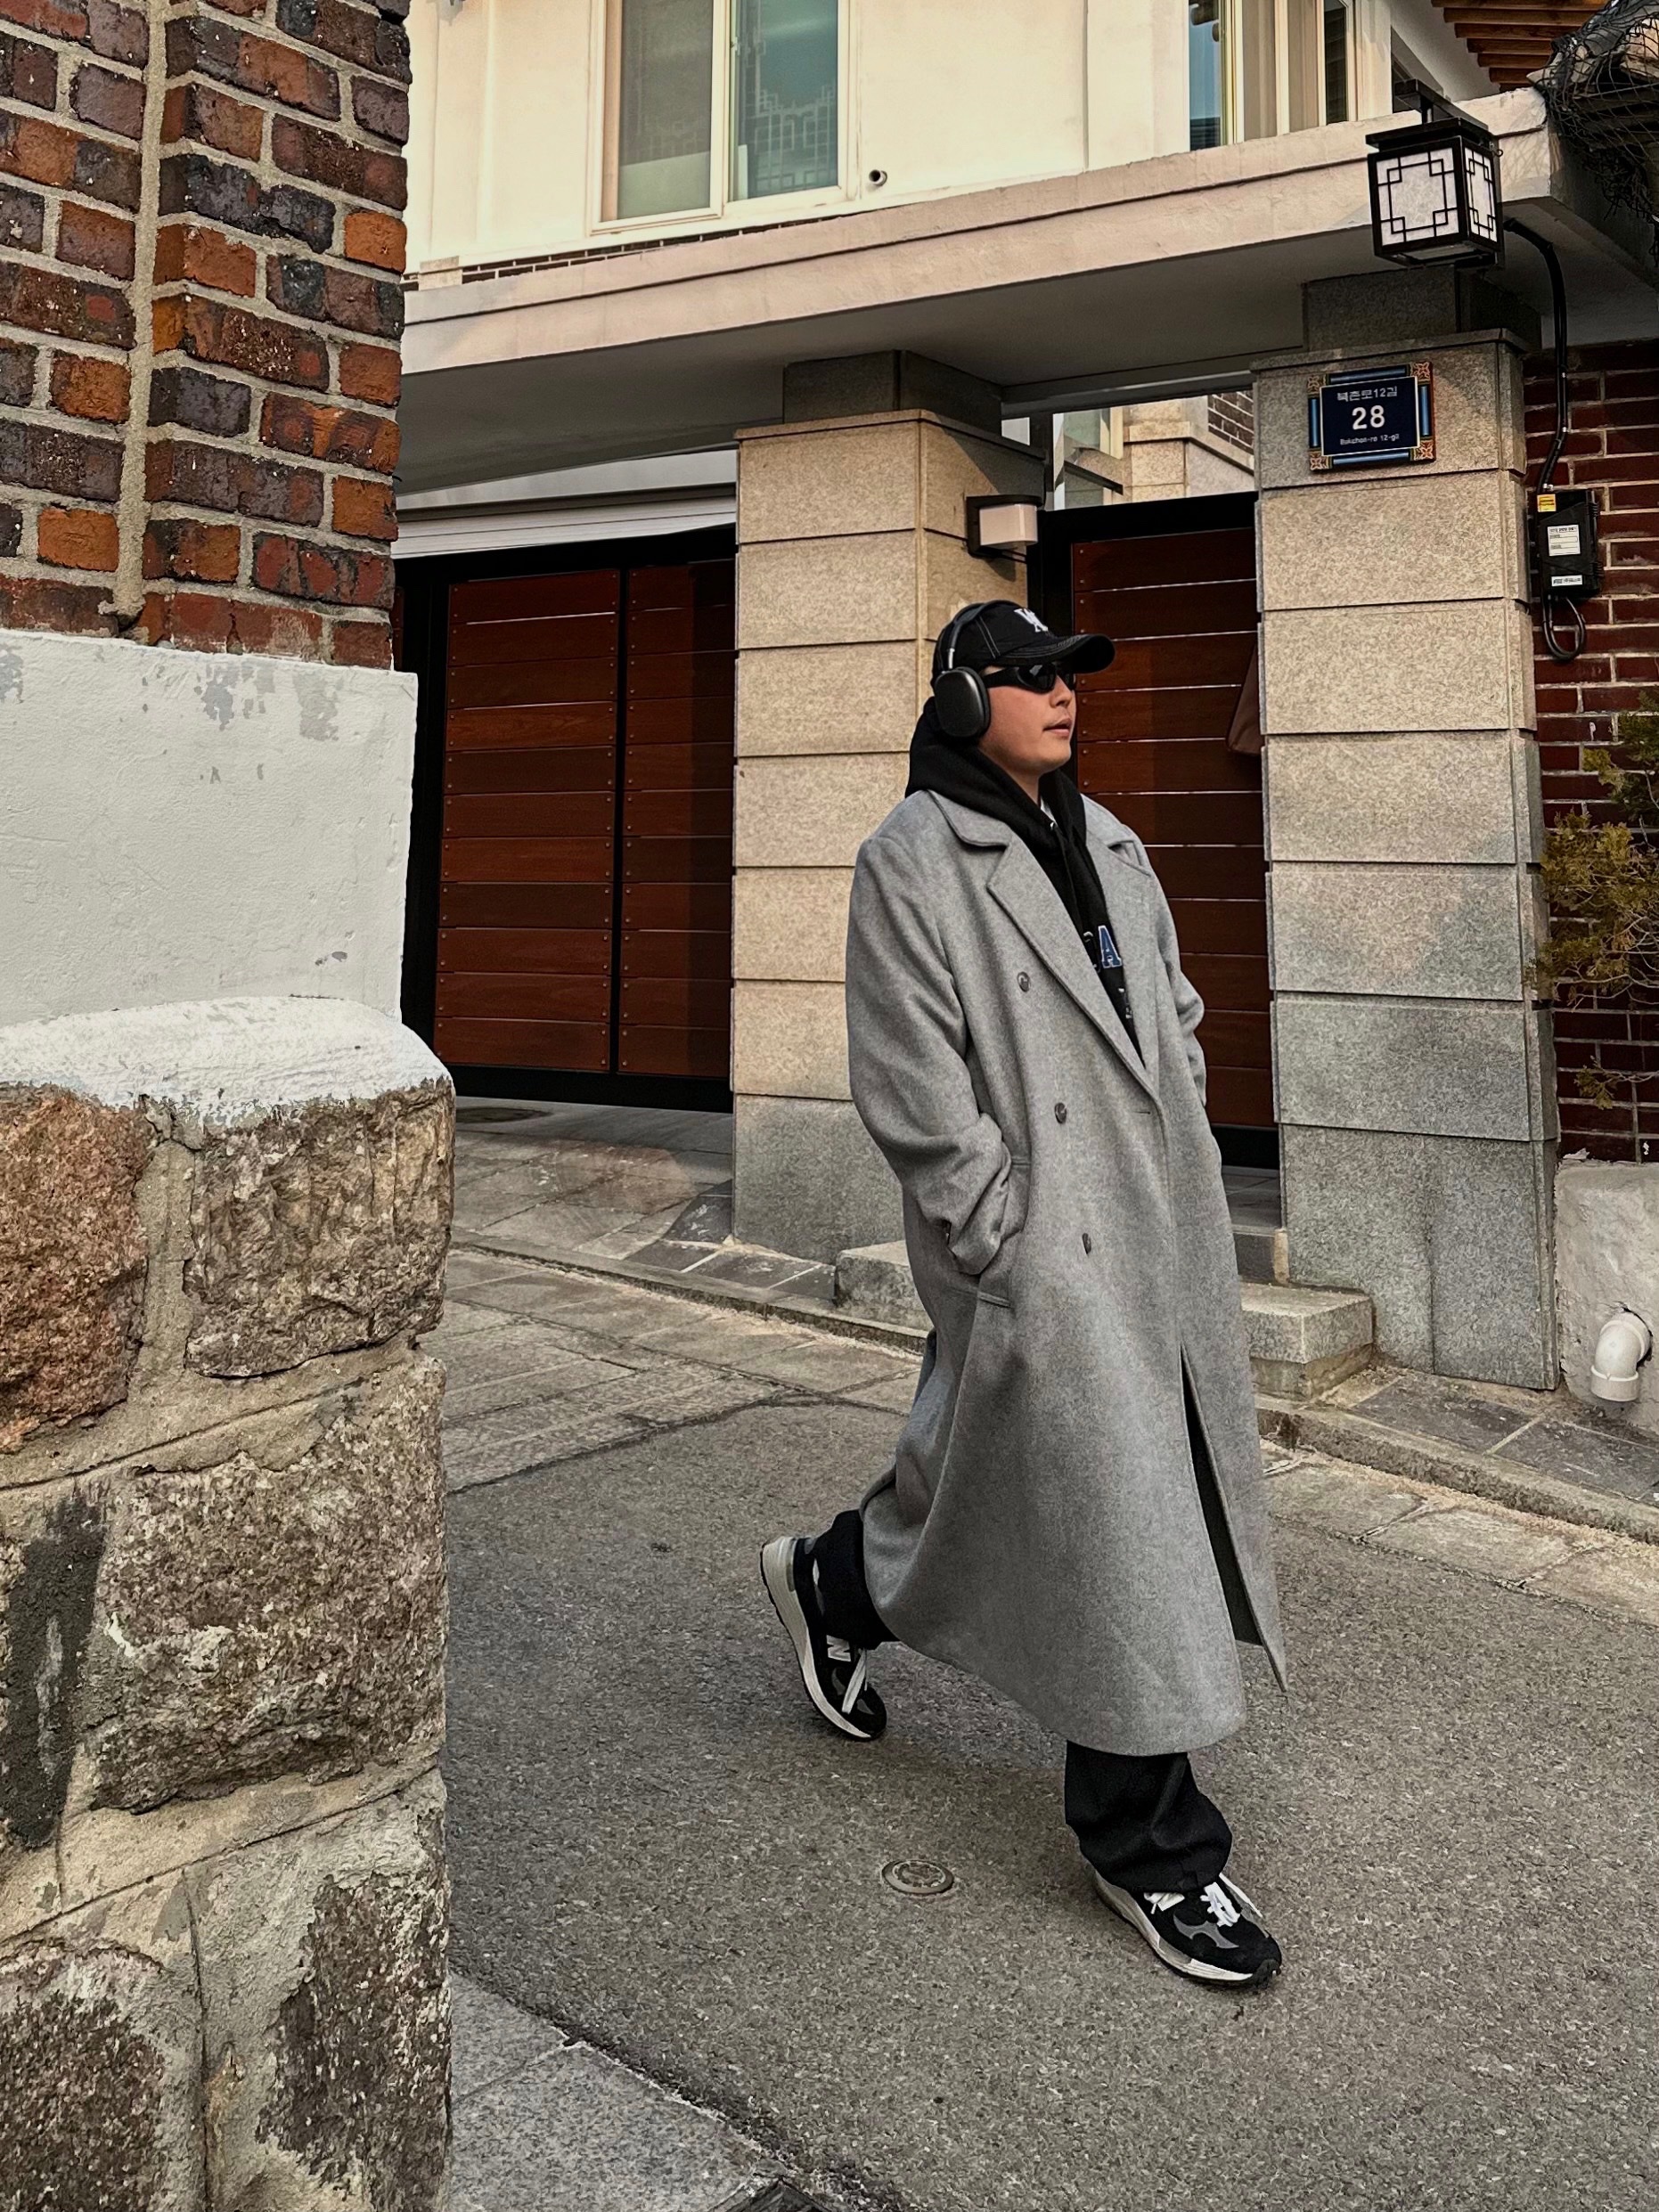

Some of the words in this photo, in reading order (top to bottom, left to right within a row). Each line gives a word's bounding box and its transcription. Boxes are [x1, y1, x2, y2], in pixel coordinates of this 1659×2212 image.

[1352, 405, 1385, 429] 28
[1098, 925, 1123, 968] A
[825, 1634, 852, 1662] N
